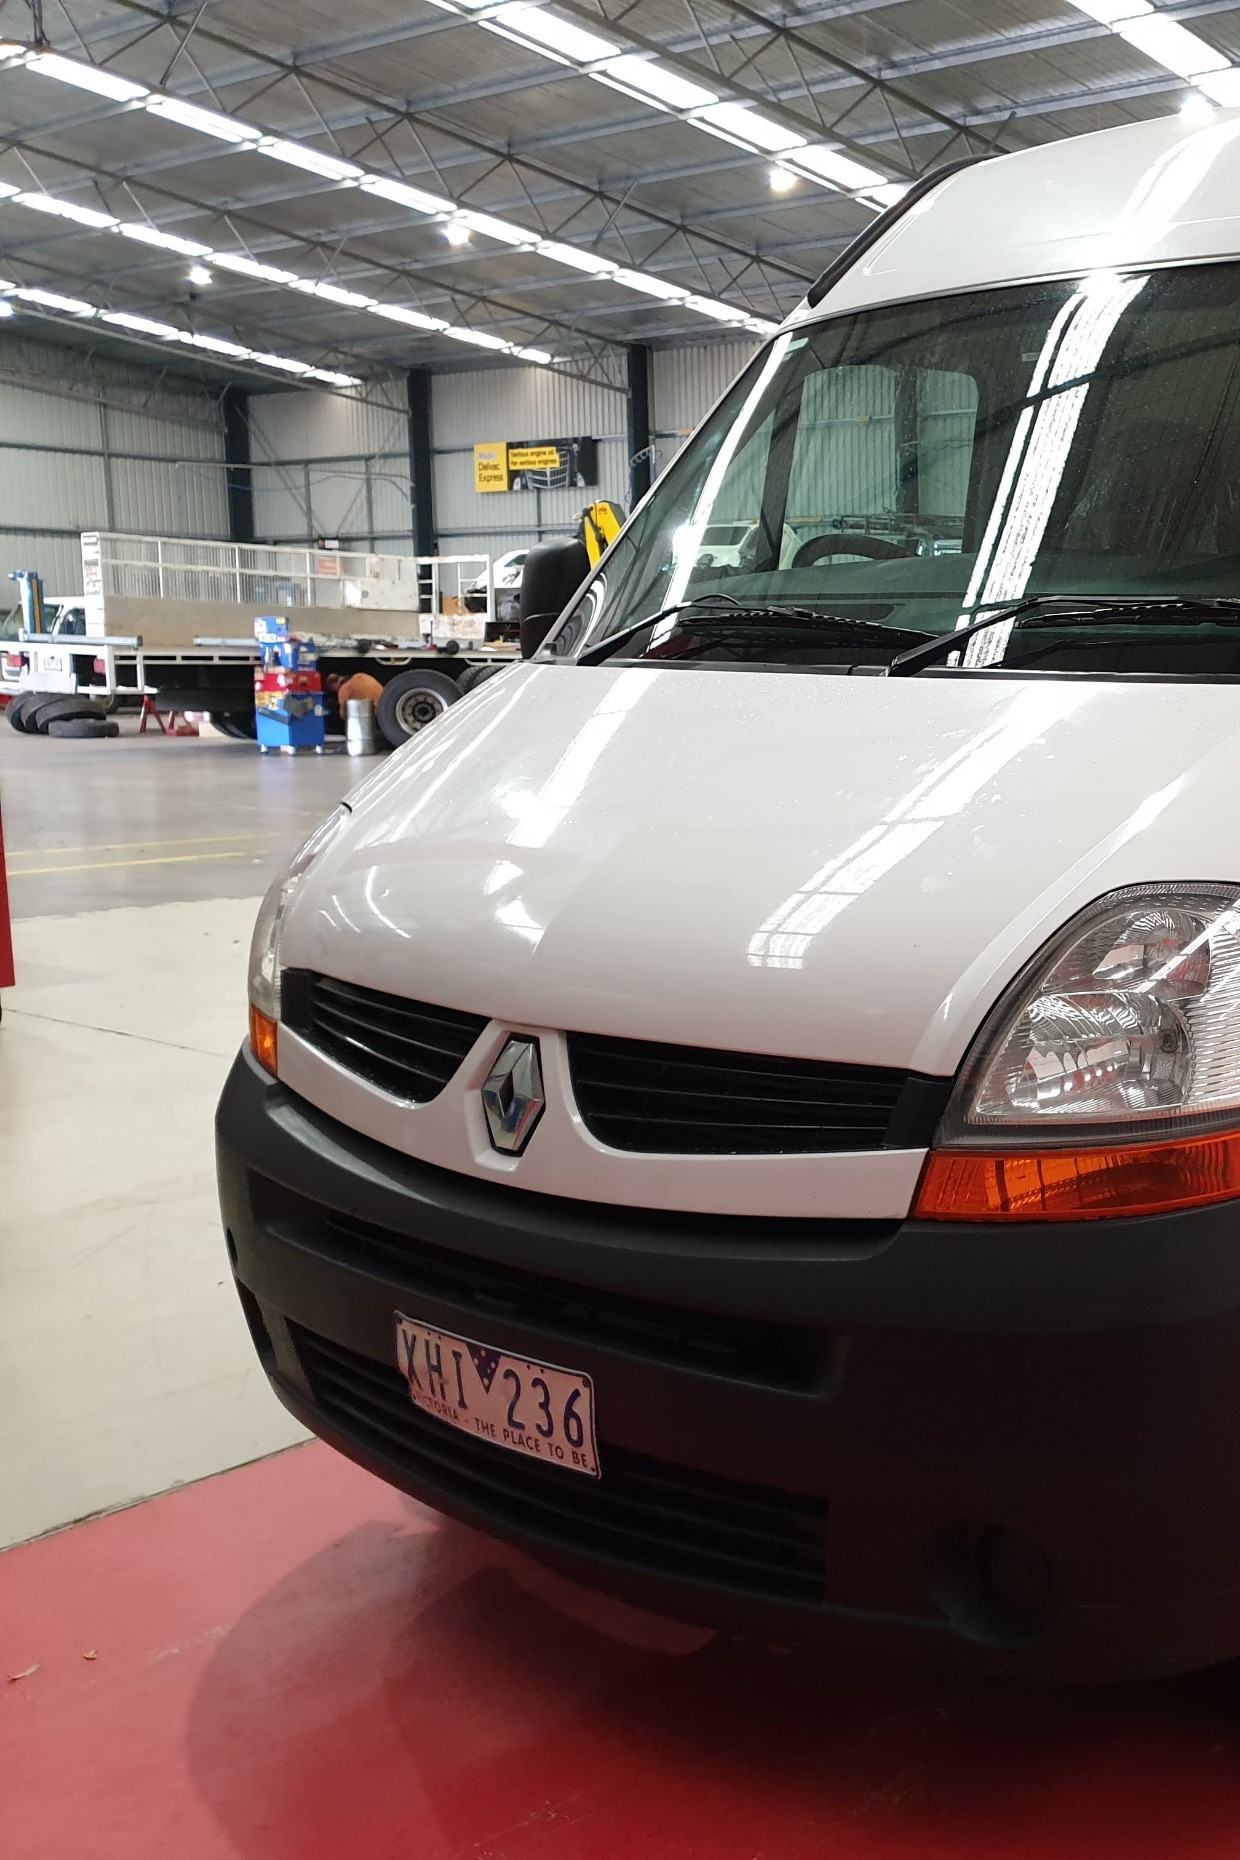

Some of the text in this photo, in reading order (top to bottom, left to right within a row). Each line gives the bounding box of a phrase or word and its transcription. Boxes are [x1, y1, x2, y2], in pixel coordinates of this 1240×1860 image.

[478, 472, 503, 483] Express
[402, 1328, 584, 1448] XHI 236
[414, 1393, 460, 1422] TORIA
[474, 1417, 497, 1438] THE
[503, 1428, 542, 1453] PLACE
[547, 1441, 565, 1460] TO
[572, 1451, 589, 1468] BE
